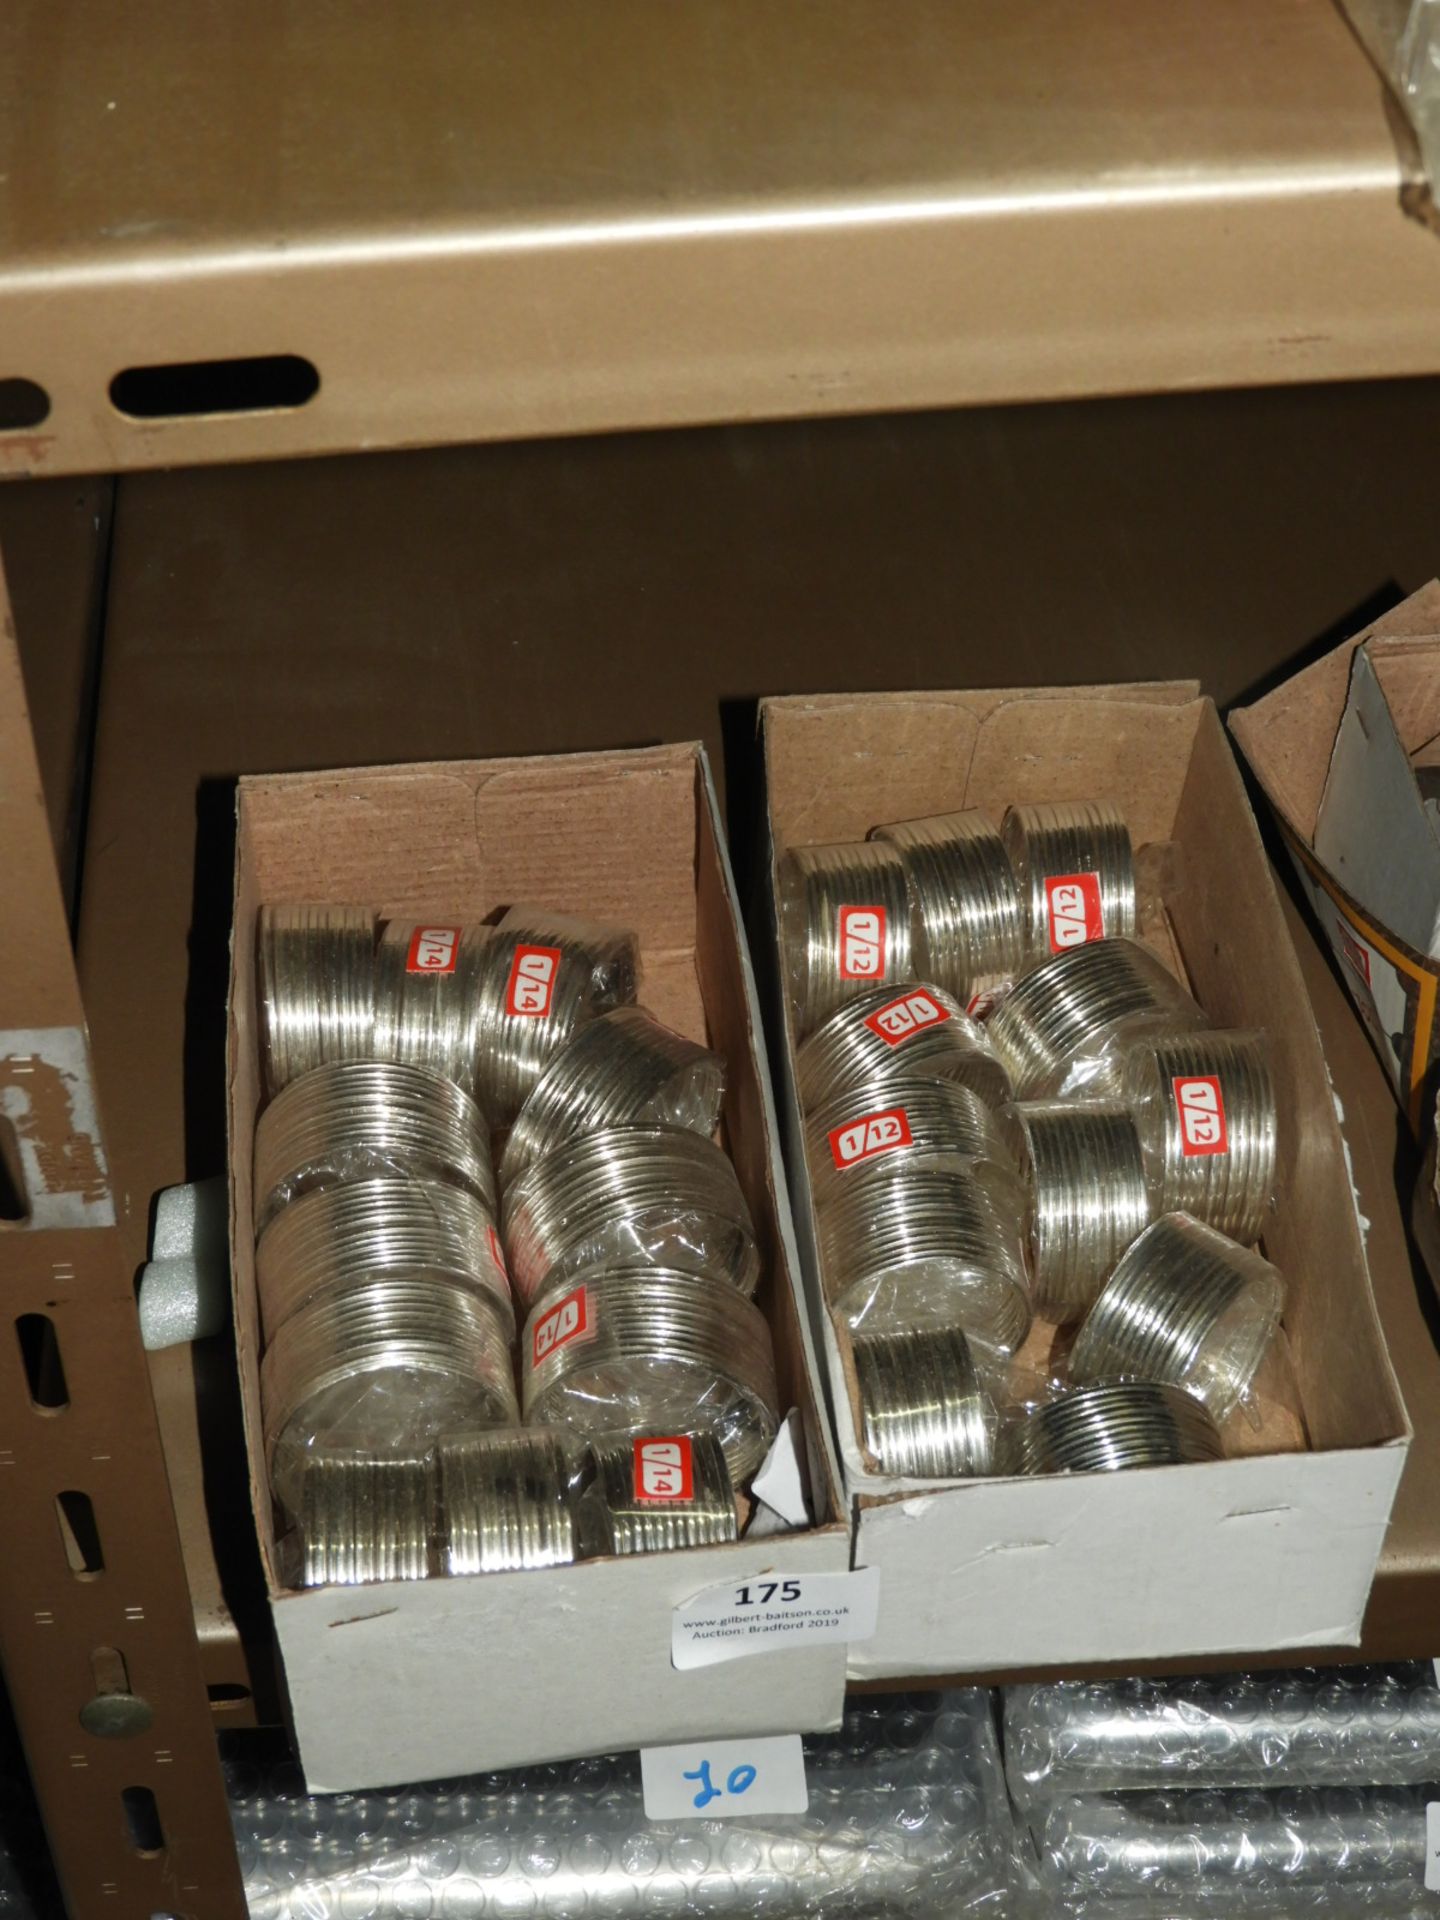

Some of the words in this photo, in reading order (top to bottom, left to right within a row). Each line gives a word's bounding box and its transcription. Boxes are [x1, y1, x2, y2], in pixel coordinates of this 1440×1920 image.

[1053, 887, 1085, 939] 1/12
[422, 932, 452, 966] 1/14
[847, 921, 878, 971] 1/12
[518, 962, 549, 1010] 1/14
[883, 1002, 930, 1031] 1/12
[1182, 1088, 1218, 1141] 1/12
[845, 1120, 899, 1157] 1/12
[643, 1448, 681, 1492] 1/14
[735, 1580, 802, 1606] 175
[683, 1607, 850, 1629] www.gilbert-baitson.co.uk
[692, 1627, 744, 1640] Auction:
[749, 1619, 804, 1634] Bradford
[808, 1618, 840, 1629] 2019
